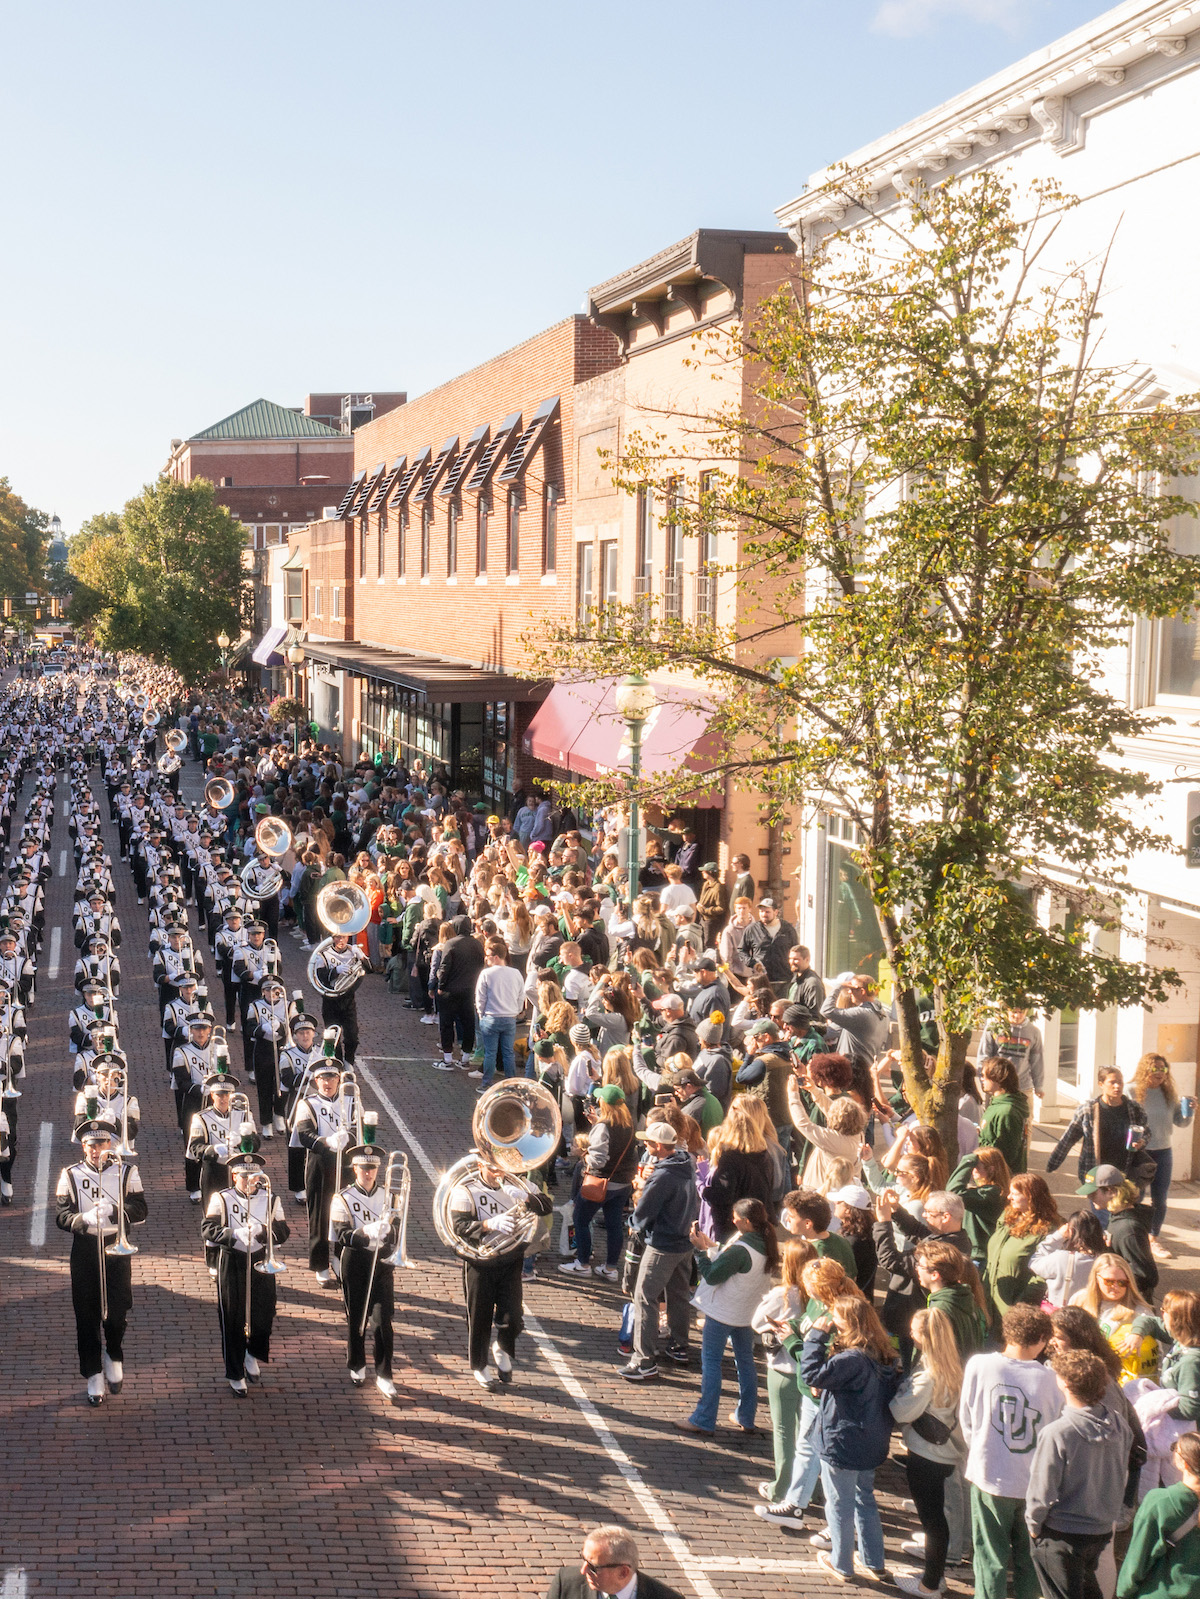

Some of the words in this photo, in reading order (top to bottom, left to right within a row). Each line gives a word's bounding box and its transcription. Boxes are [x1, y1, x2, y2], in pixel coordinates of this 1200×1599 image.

[168, 955, 179, 967] OH
[250, 953, 260, 964] OH
[191, 1057, 209, 1075] OHI
[321, 1107, 339, 1126] OHI
[211, 1124, 226, 1139] OH
[82, 1179, 104, 1198] OH
[233, 1204, 248, 1223] OH
[353, 1203, 376, 1222] OH
[480, 1196, 503, 1214] OH
